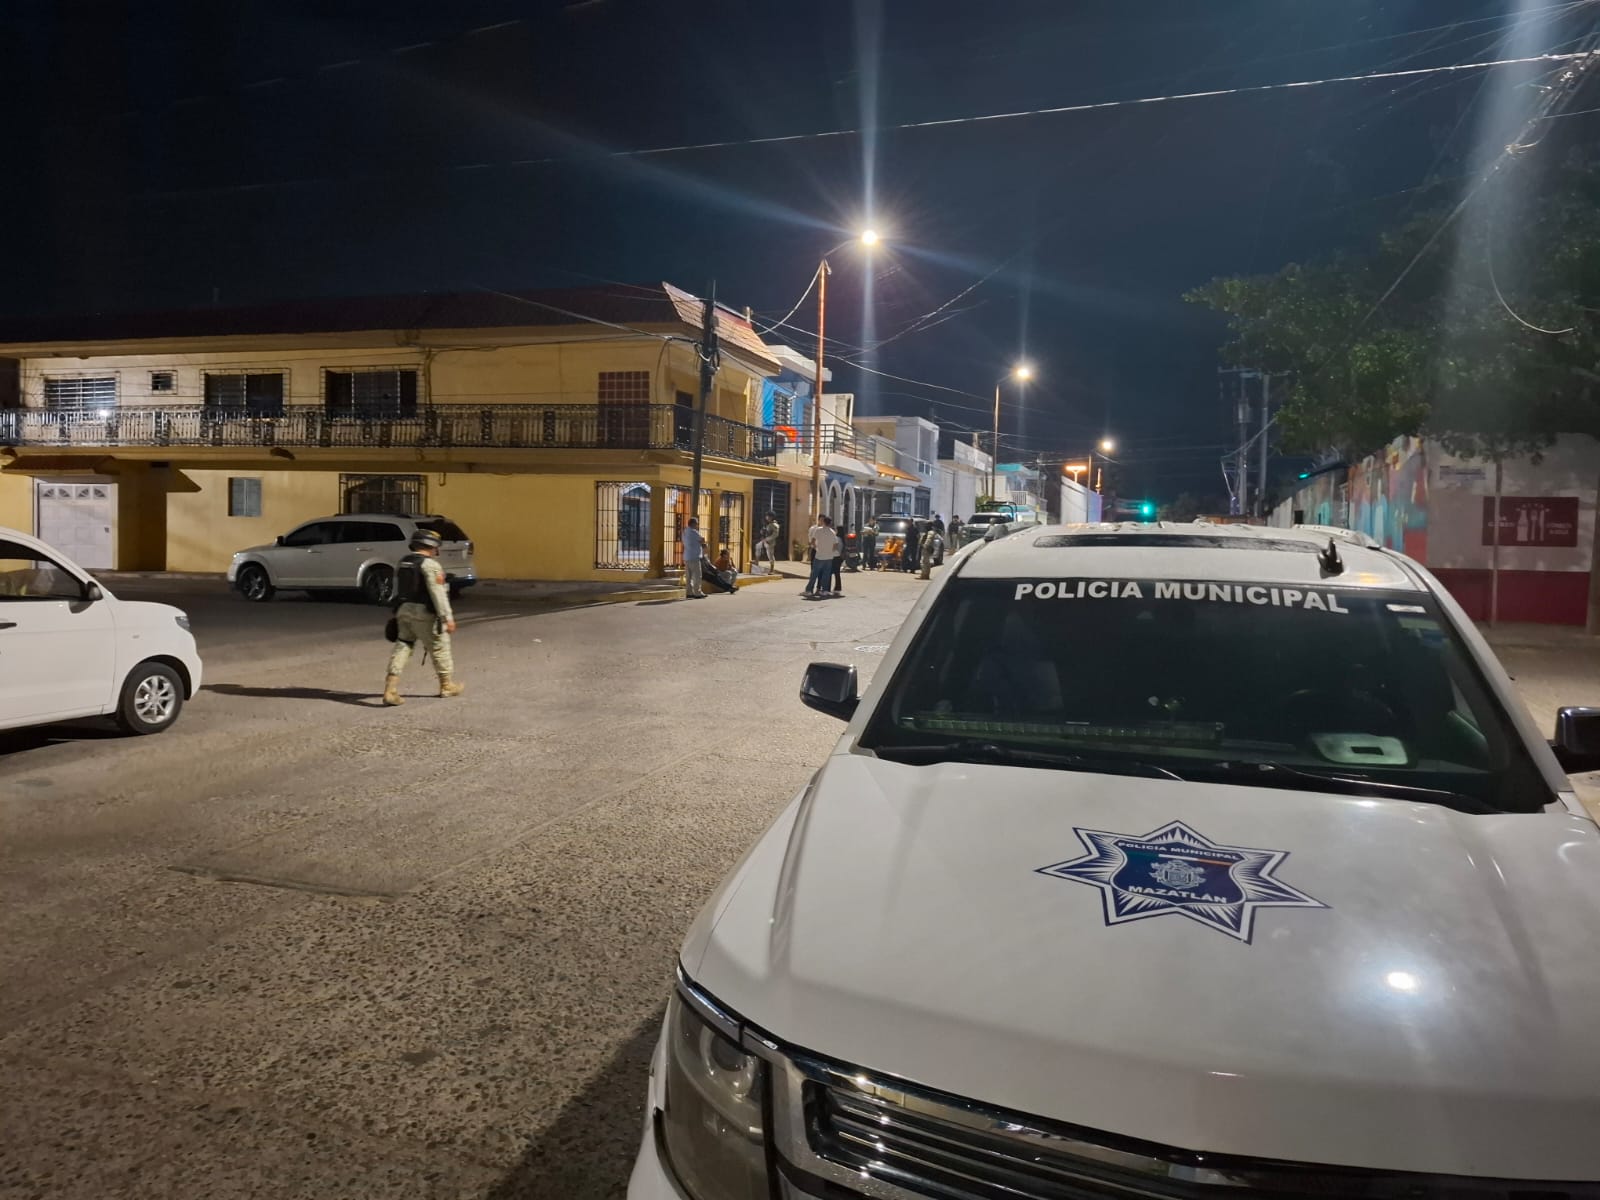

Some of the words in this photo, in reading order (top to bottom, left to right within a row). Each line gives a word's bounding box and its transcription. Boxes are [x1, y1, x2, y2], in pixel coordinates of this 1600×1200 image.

[1014, 581, 1144, 600] POLICIA
[1154, 582, 1349, 614] MUNICIPAL
[1171, 847, 1240, 860] MUNICIPAL
